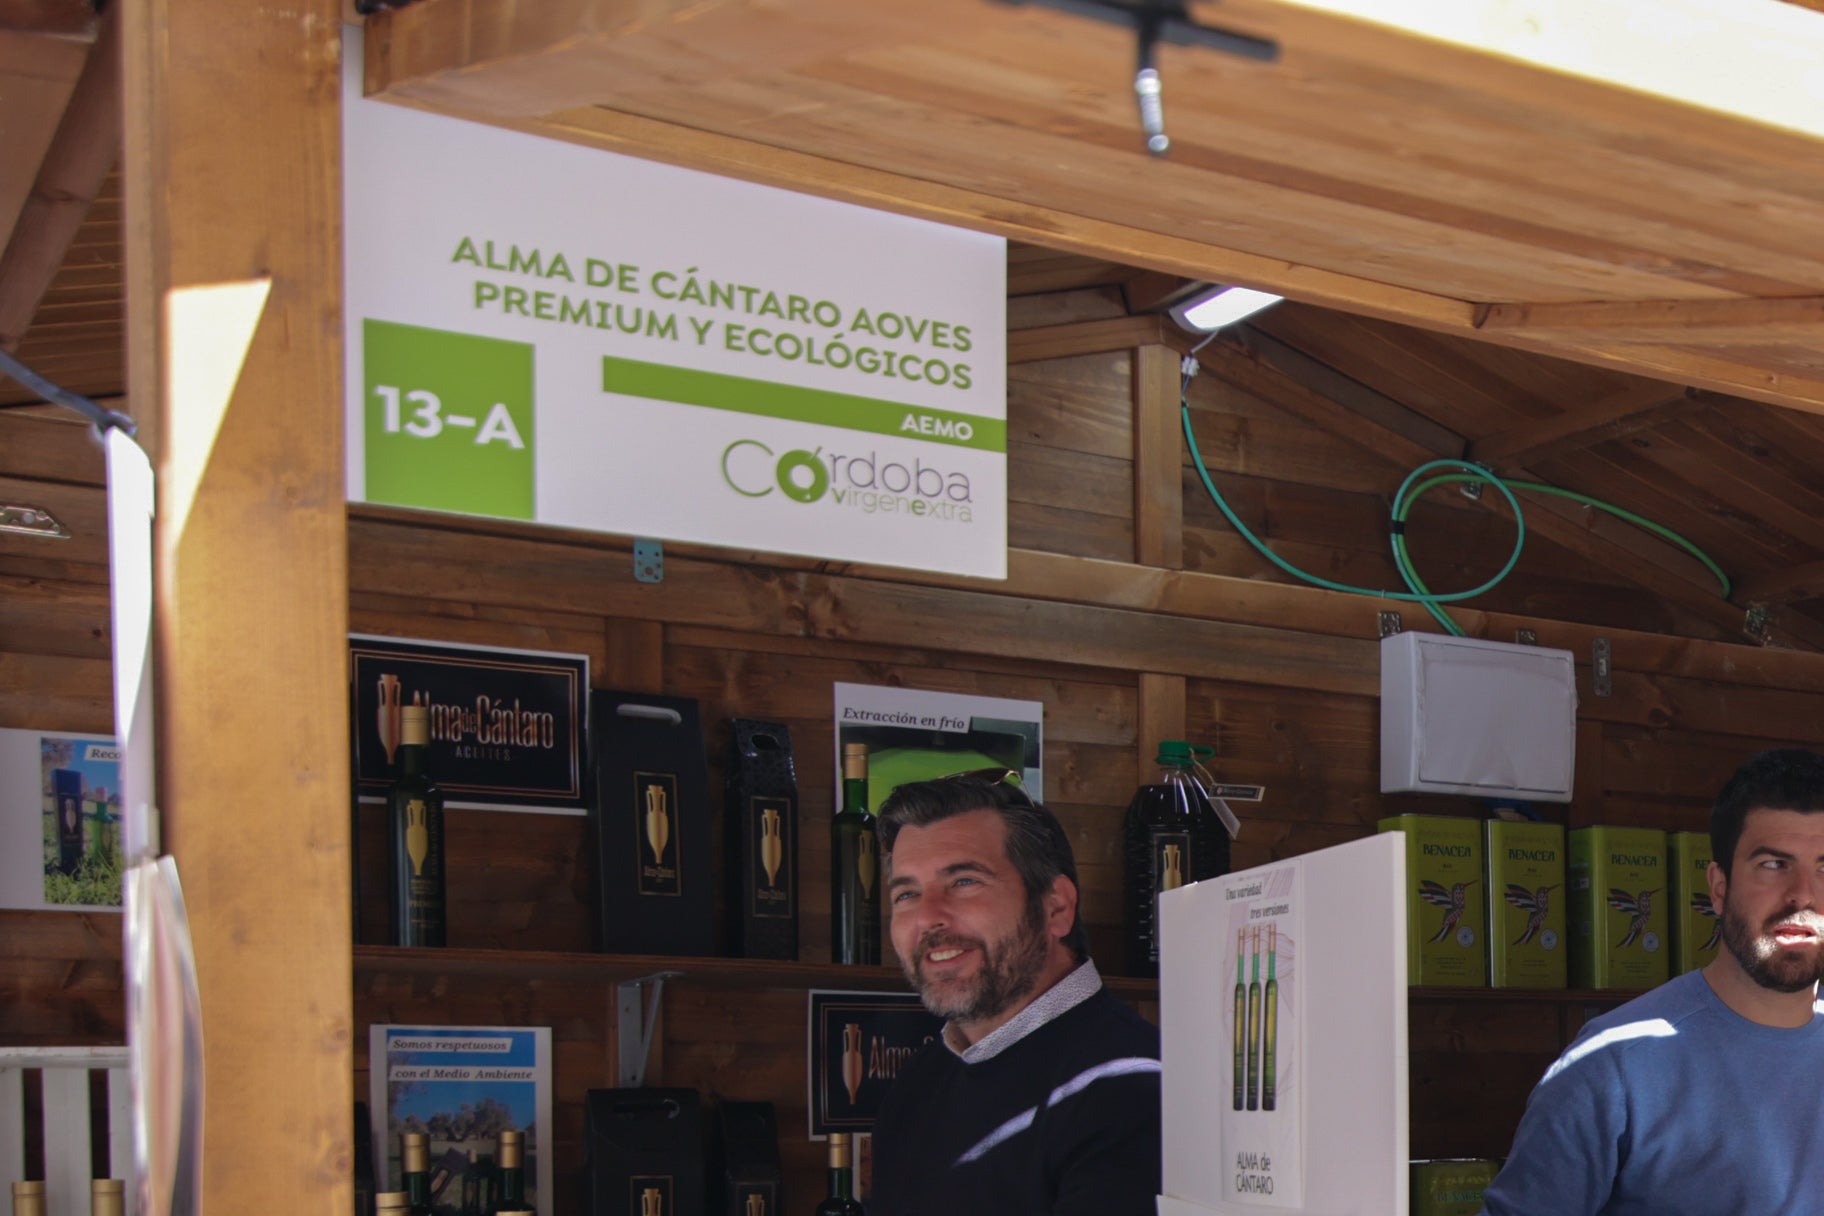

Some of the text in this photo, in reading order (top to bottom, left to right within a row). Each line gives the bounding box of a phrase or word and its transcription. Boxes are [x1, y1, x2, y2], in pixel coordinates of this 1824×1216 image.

[452, 234, 973, 353] ALMA DE CÁNTARO AOVES
[473, 280, 973, 391] PREMIUM Y ECOLÓGICOS
[373, 384, 526, 451] 13-A
[899, 412, 974, 441] AEMO
[721, 438, 973, 504] Córdoba
[831, 487, 973, 525] virgenextra
[842, 706, 965, 730] Extracción en frío
[393, 1039, 507, 1052] Somos respetuosos
[395, 1069, 533, 1079] con el Medio Ambiente
[1237, 1151, 1271, 1171] ALMA de
[1236, 1170, 1274, 1195] CÁNTARO
